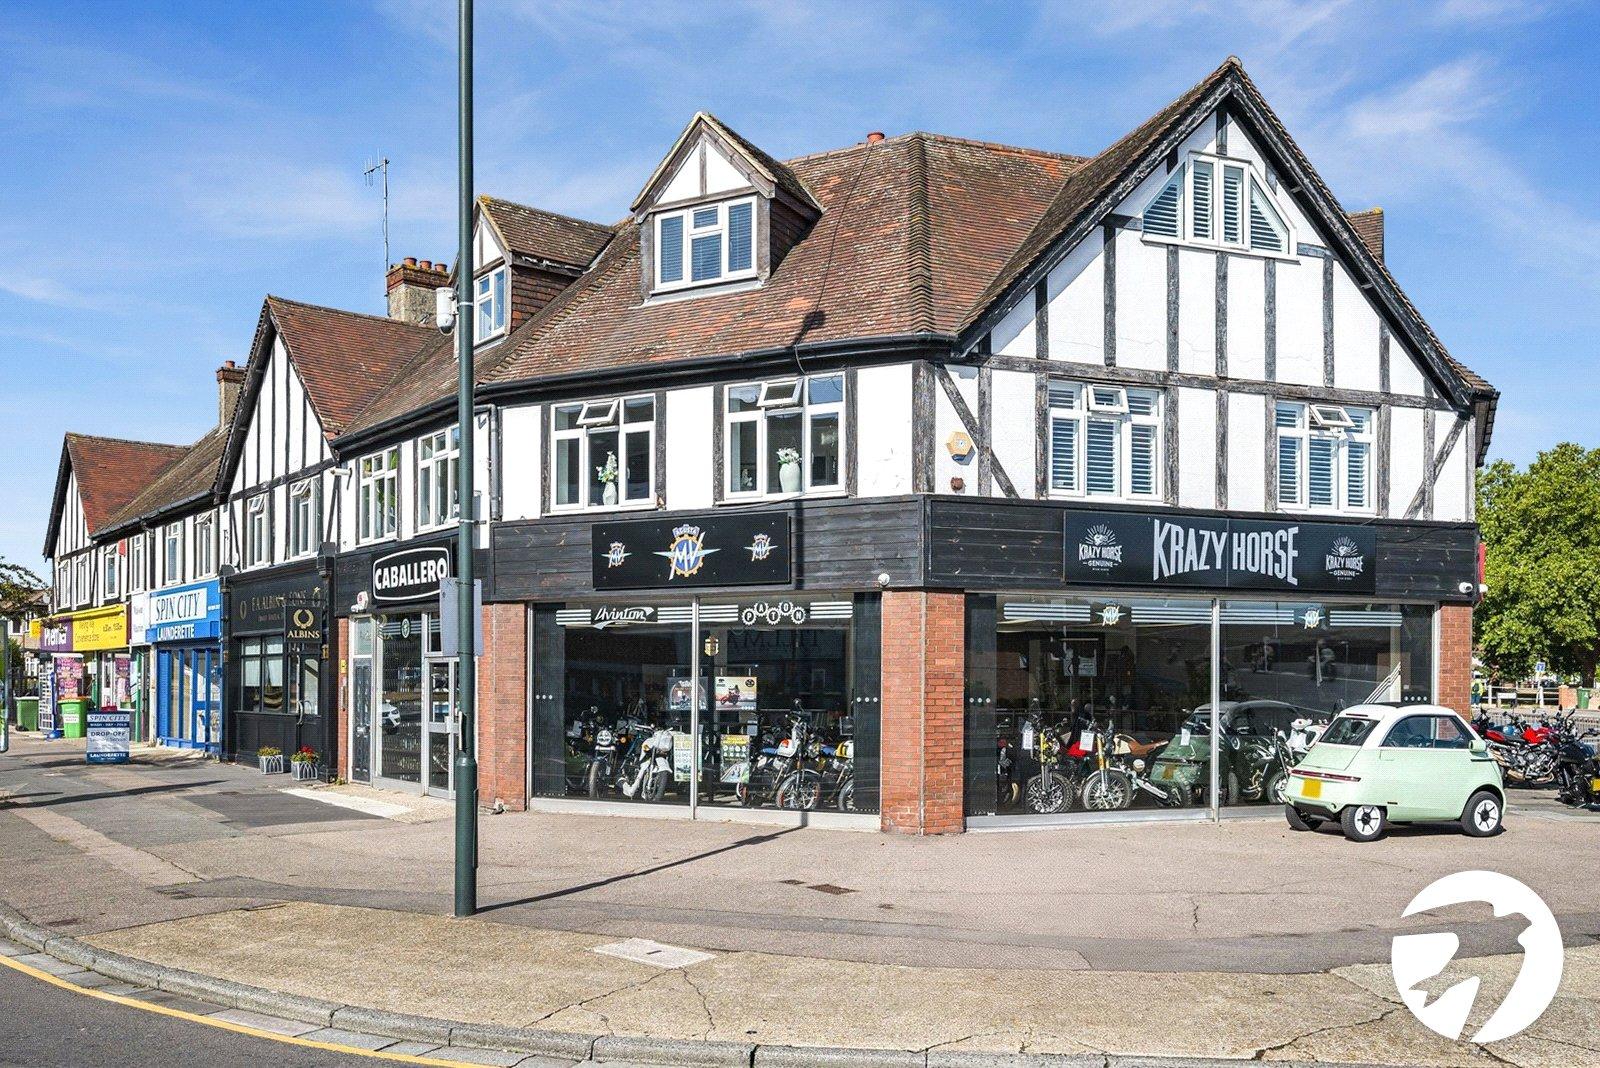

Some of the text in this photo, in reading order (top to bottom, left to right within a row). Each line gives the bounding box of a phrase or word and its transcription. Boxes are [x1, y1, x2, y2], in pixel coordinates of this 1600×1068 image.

[1078, 543, 1122, 562] KRAZY HORSE
[1153, 519, 1298, 586] KRAZY HORSE
[1325, 554, 1363, 572] KRAZY HORSE
[374, 557, 448, 590] CABALLERO
[156, 592, 200, 621] SPIN CITY
[744, 602, 804, 624] PATON
[157, 624, 195, 641] LAUNDERETTE
[287, 630, 320, 639] ALBINS
